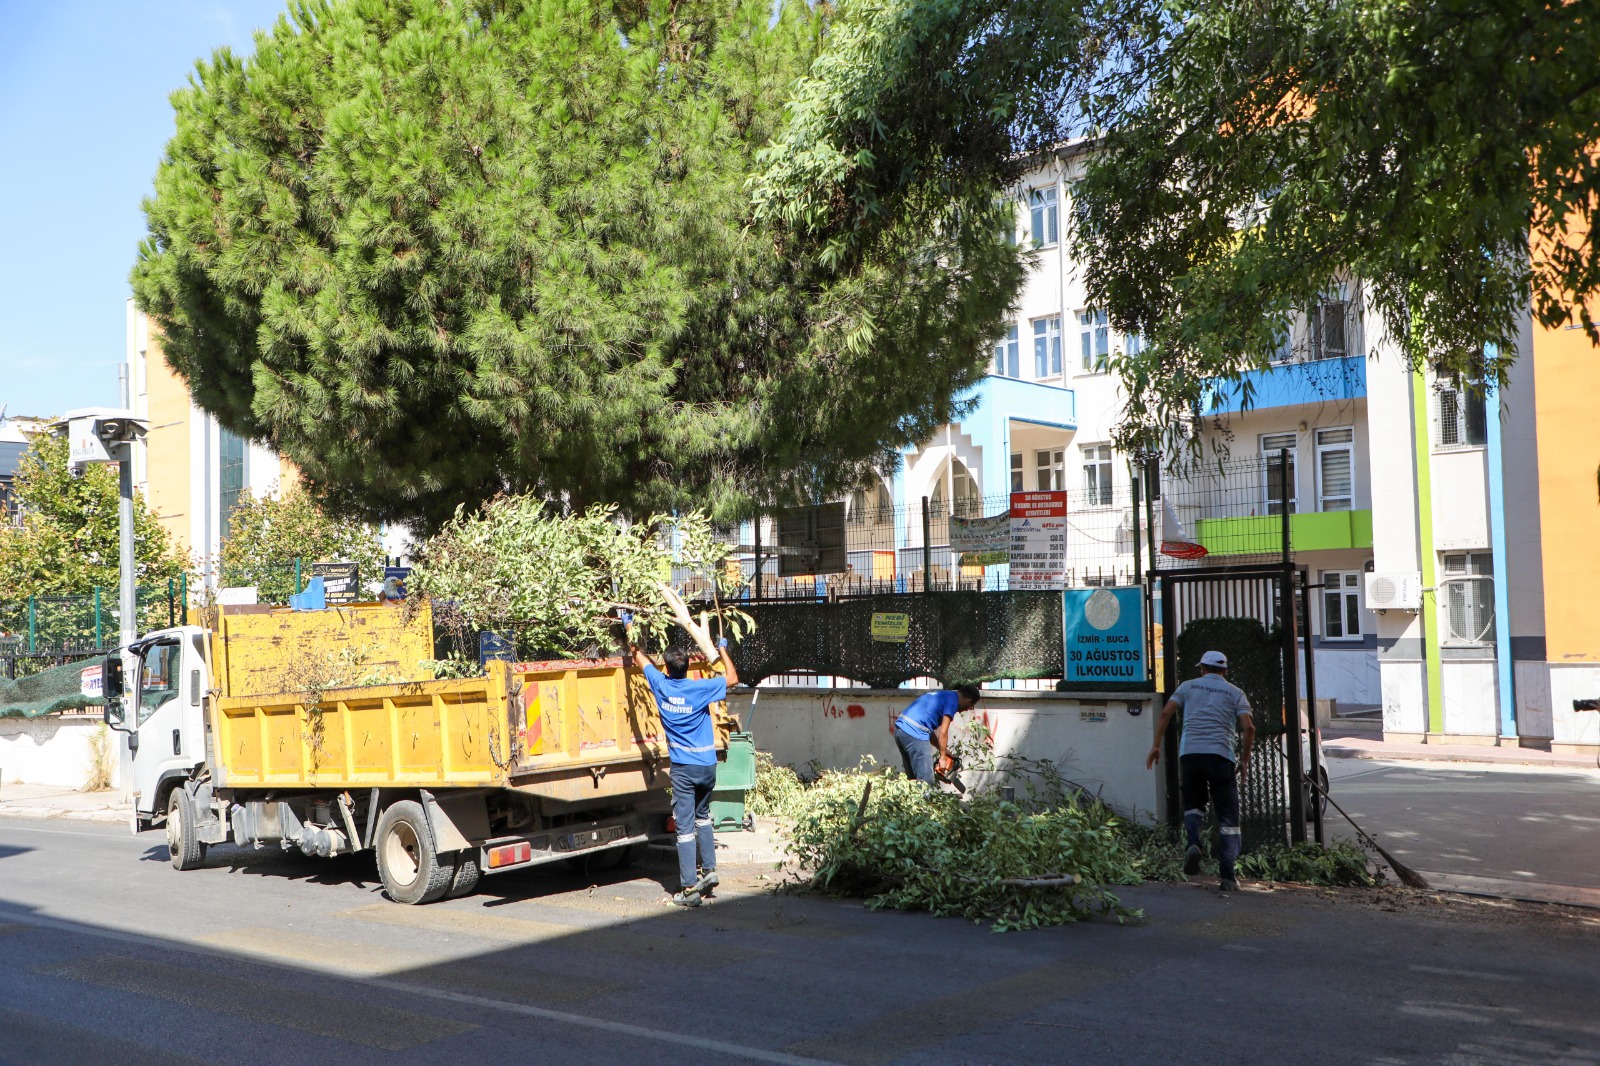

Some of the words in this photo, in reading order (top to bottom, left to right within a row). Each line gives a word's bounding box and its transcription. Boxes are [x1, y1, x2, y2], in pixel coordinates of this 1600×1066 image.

[1078, 635, 1100, 644] İZMİR
[1070, 650, 1082, 661] 30
[1086, 648, 1140, 661] AĞUSTOS
[1076, 664, 1134, 676] İLKOKULU
[575, 834, 586, 846] 35
